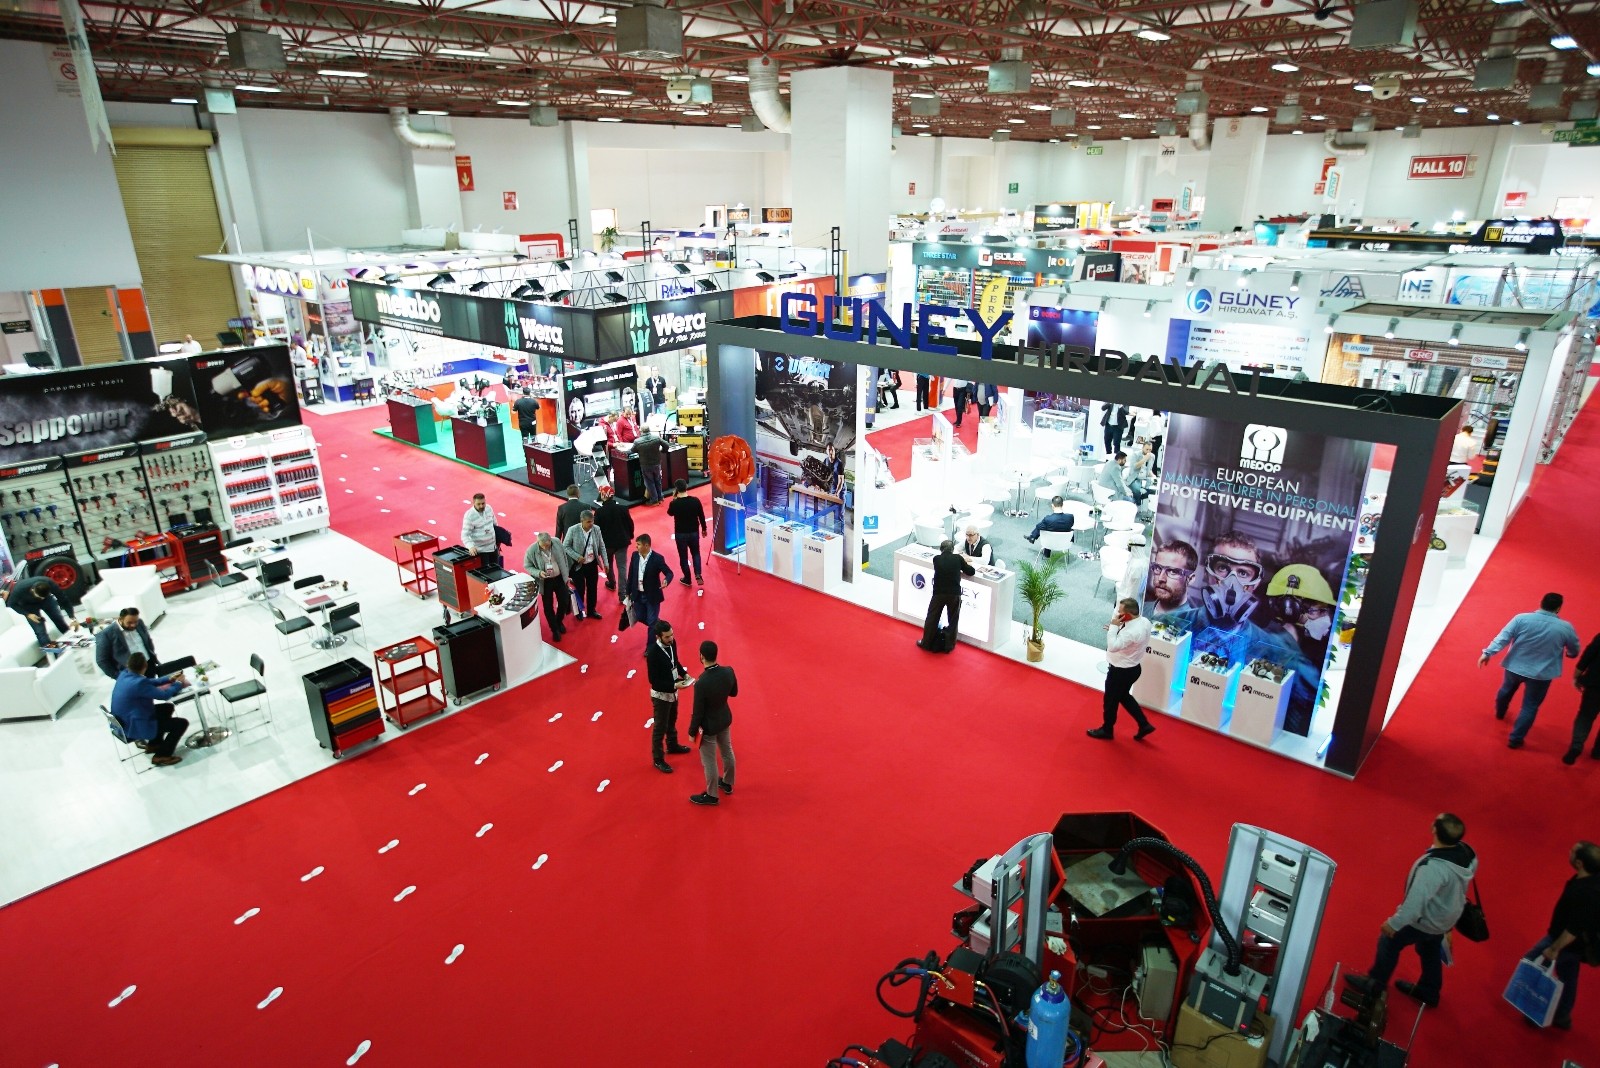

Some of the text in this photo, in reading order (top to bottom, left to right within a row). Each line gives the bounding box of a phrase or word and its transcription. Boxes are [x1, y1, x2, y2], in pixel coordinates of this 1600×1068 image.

[1412, 160, 1463, 174] HALL 10
[922, 251, 957, 260] THREE STAR
[375, 291, 442, 323] metabo
[1218, 305, 1274, 316] HIRDAVAT
[1219, 288, 1300, 309] GÜNEY
[519, 316, 564, 345] Wera
[652, 312, 707, 338] Wera
[781, 291, 1015, 361] GÜNEY
[1017, 338, 1275, 398] HIRDAVAT
[1409, 350, 1434, 360] CRC
[44, 378, 124, 393] pneumatic tools
[0, 407, 130, 447] Sappower
[1239, 458, 1282, 474] MEDOP
[1164, 471, 1357, 518] MANUFACTURER IN PERSONAL
[1216, 467, 1300, 495] EUROPEAN
[1161, 481, 1356, 533] PROTECTIVE EQUIPMENT
